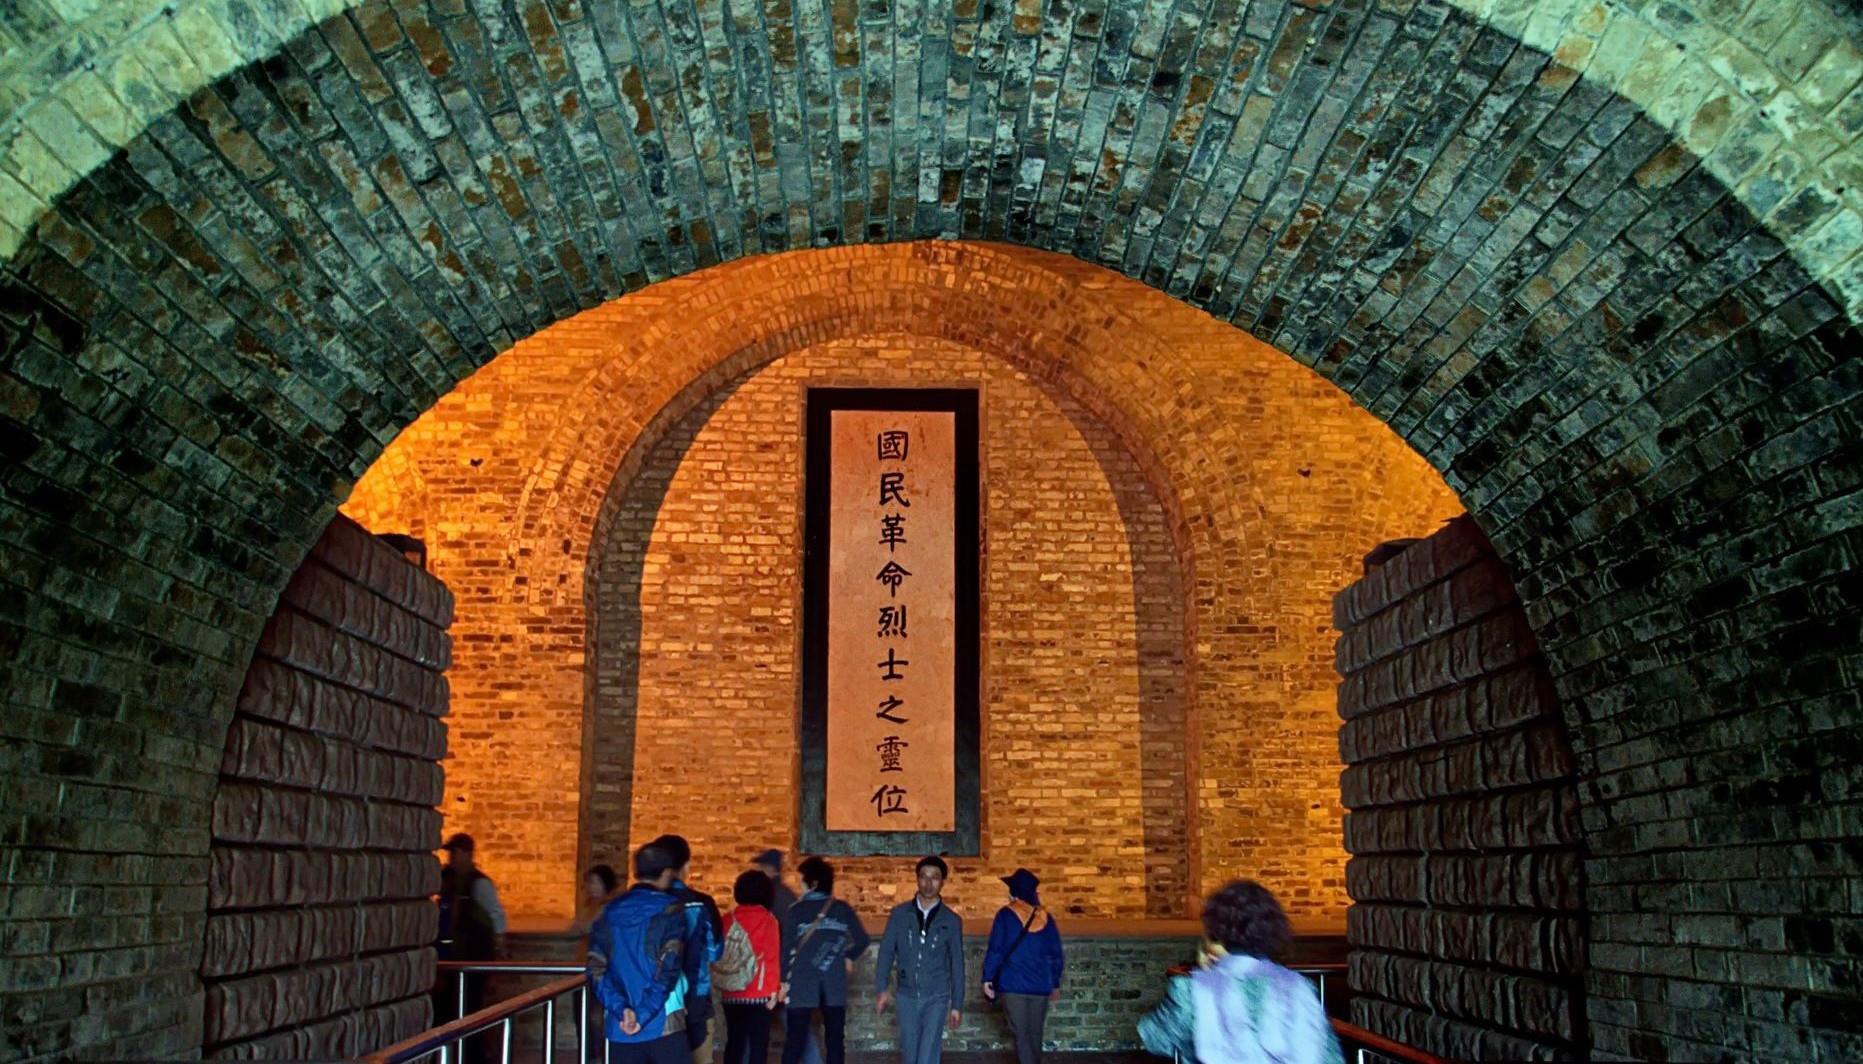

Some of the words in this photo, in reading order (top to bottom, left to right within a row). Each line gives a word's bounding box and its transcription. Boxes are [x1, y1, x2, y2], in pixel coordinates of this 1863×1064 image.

[871, 431, 912, 817] 國民革命烈士之靈位
